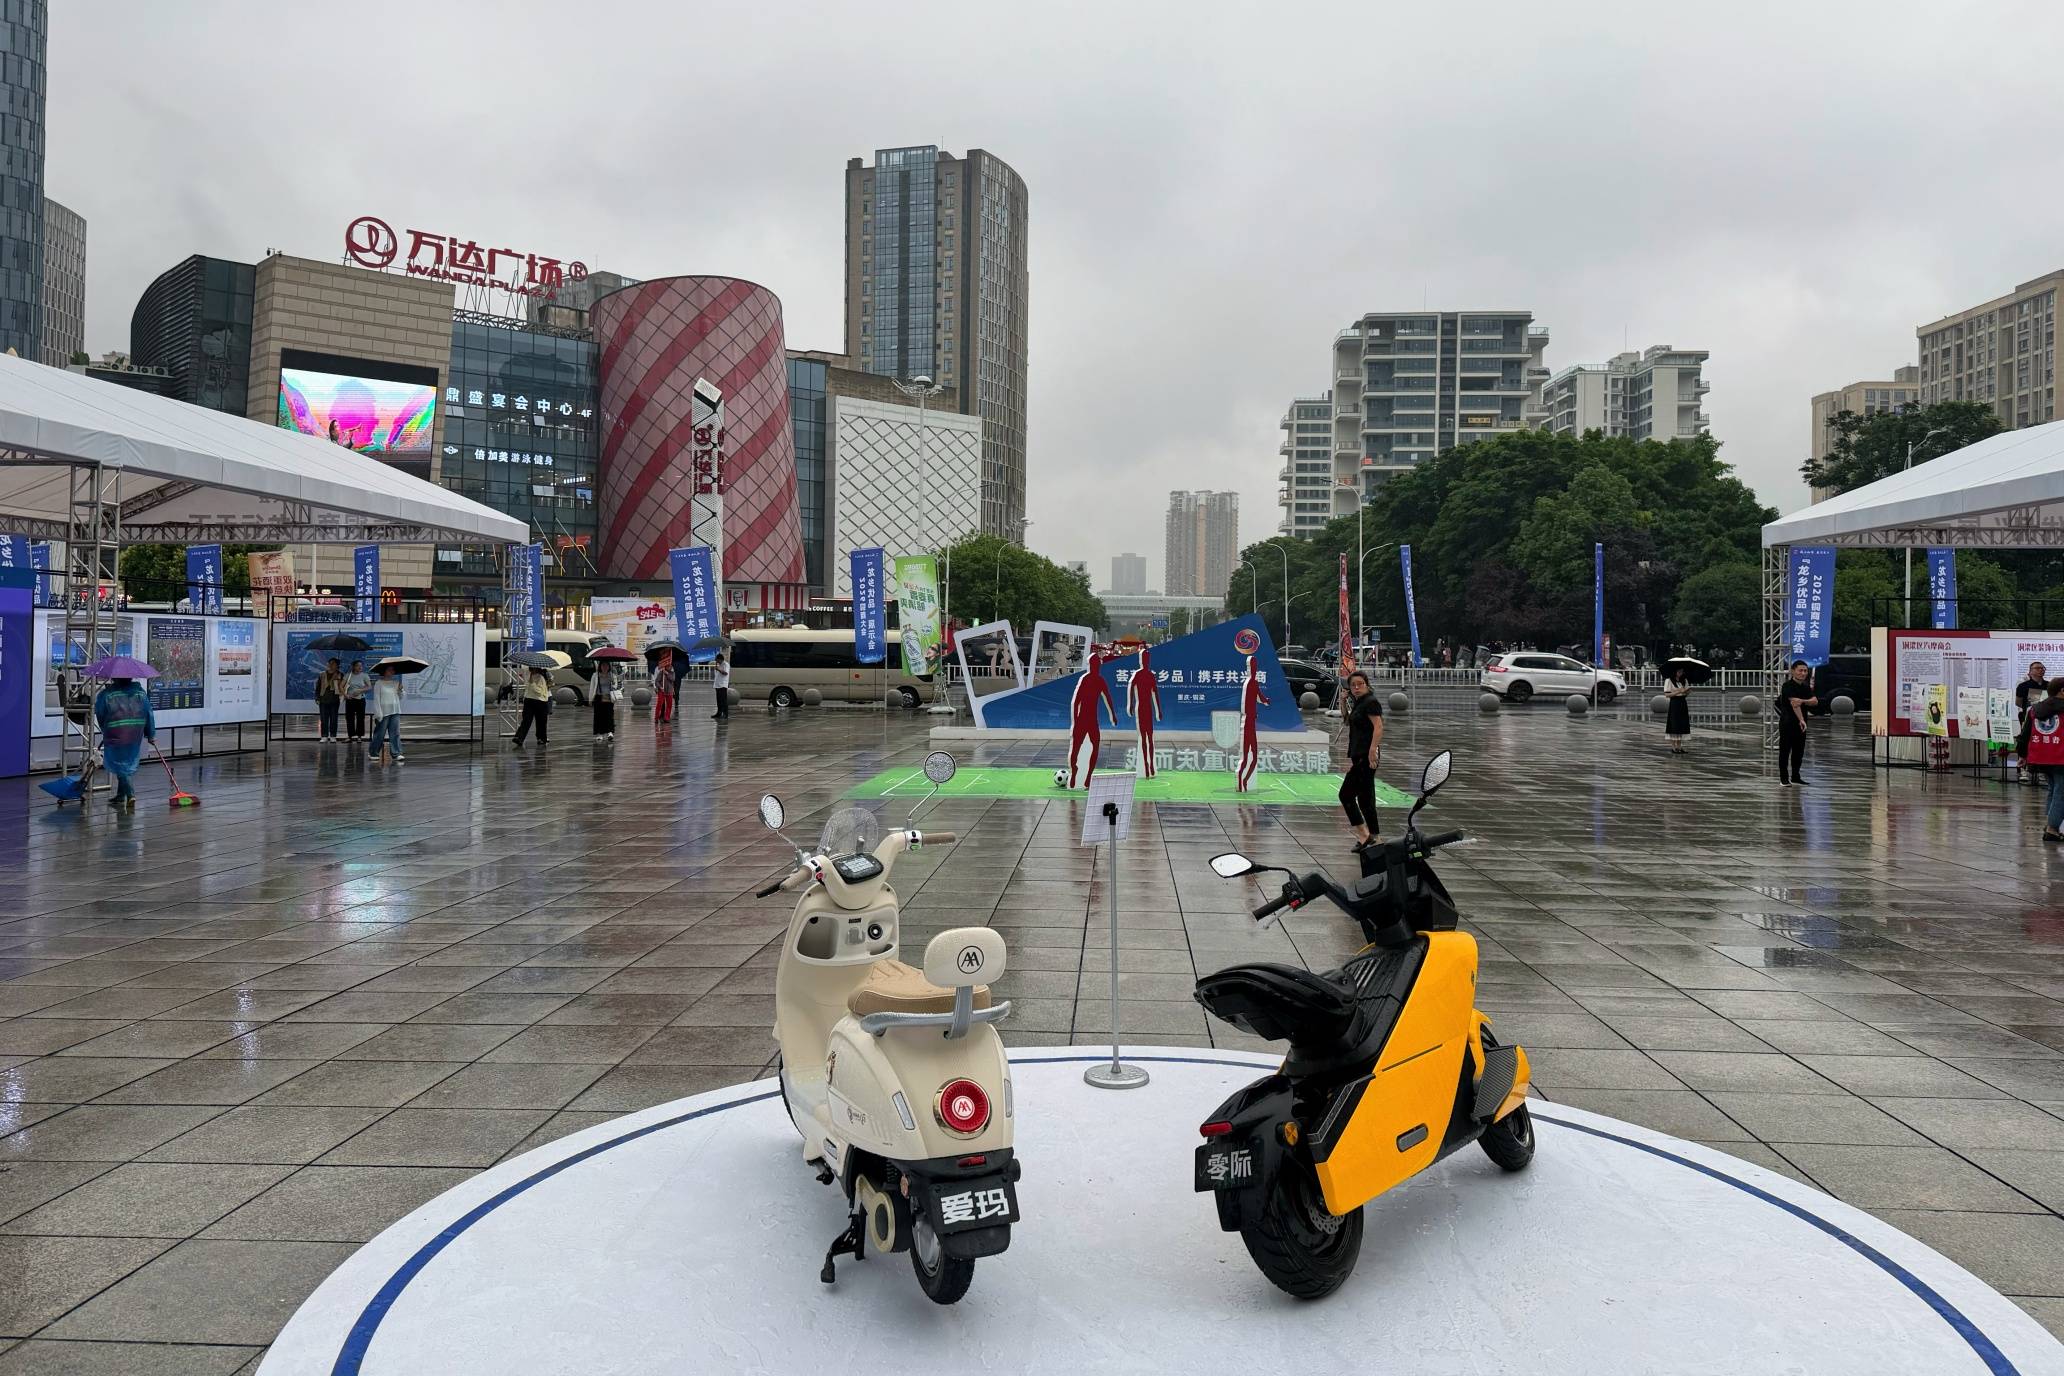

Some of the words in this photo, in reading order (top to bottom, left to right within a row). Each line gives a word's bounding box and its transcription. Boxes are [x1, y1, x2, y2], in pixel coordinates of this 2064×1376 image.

[406, 229, 563, 288] 万达广场
[406, 262, 487, 288] WANDA
[1809, 575, 1823, 638] 2026铜商大会
[1207, 1149, 1253, 1181] 零际
[941, 1187, 1010, 1225] 爱玛
